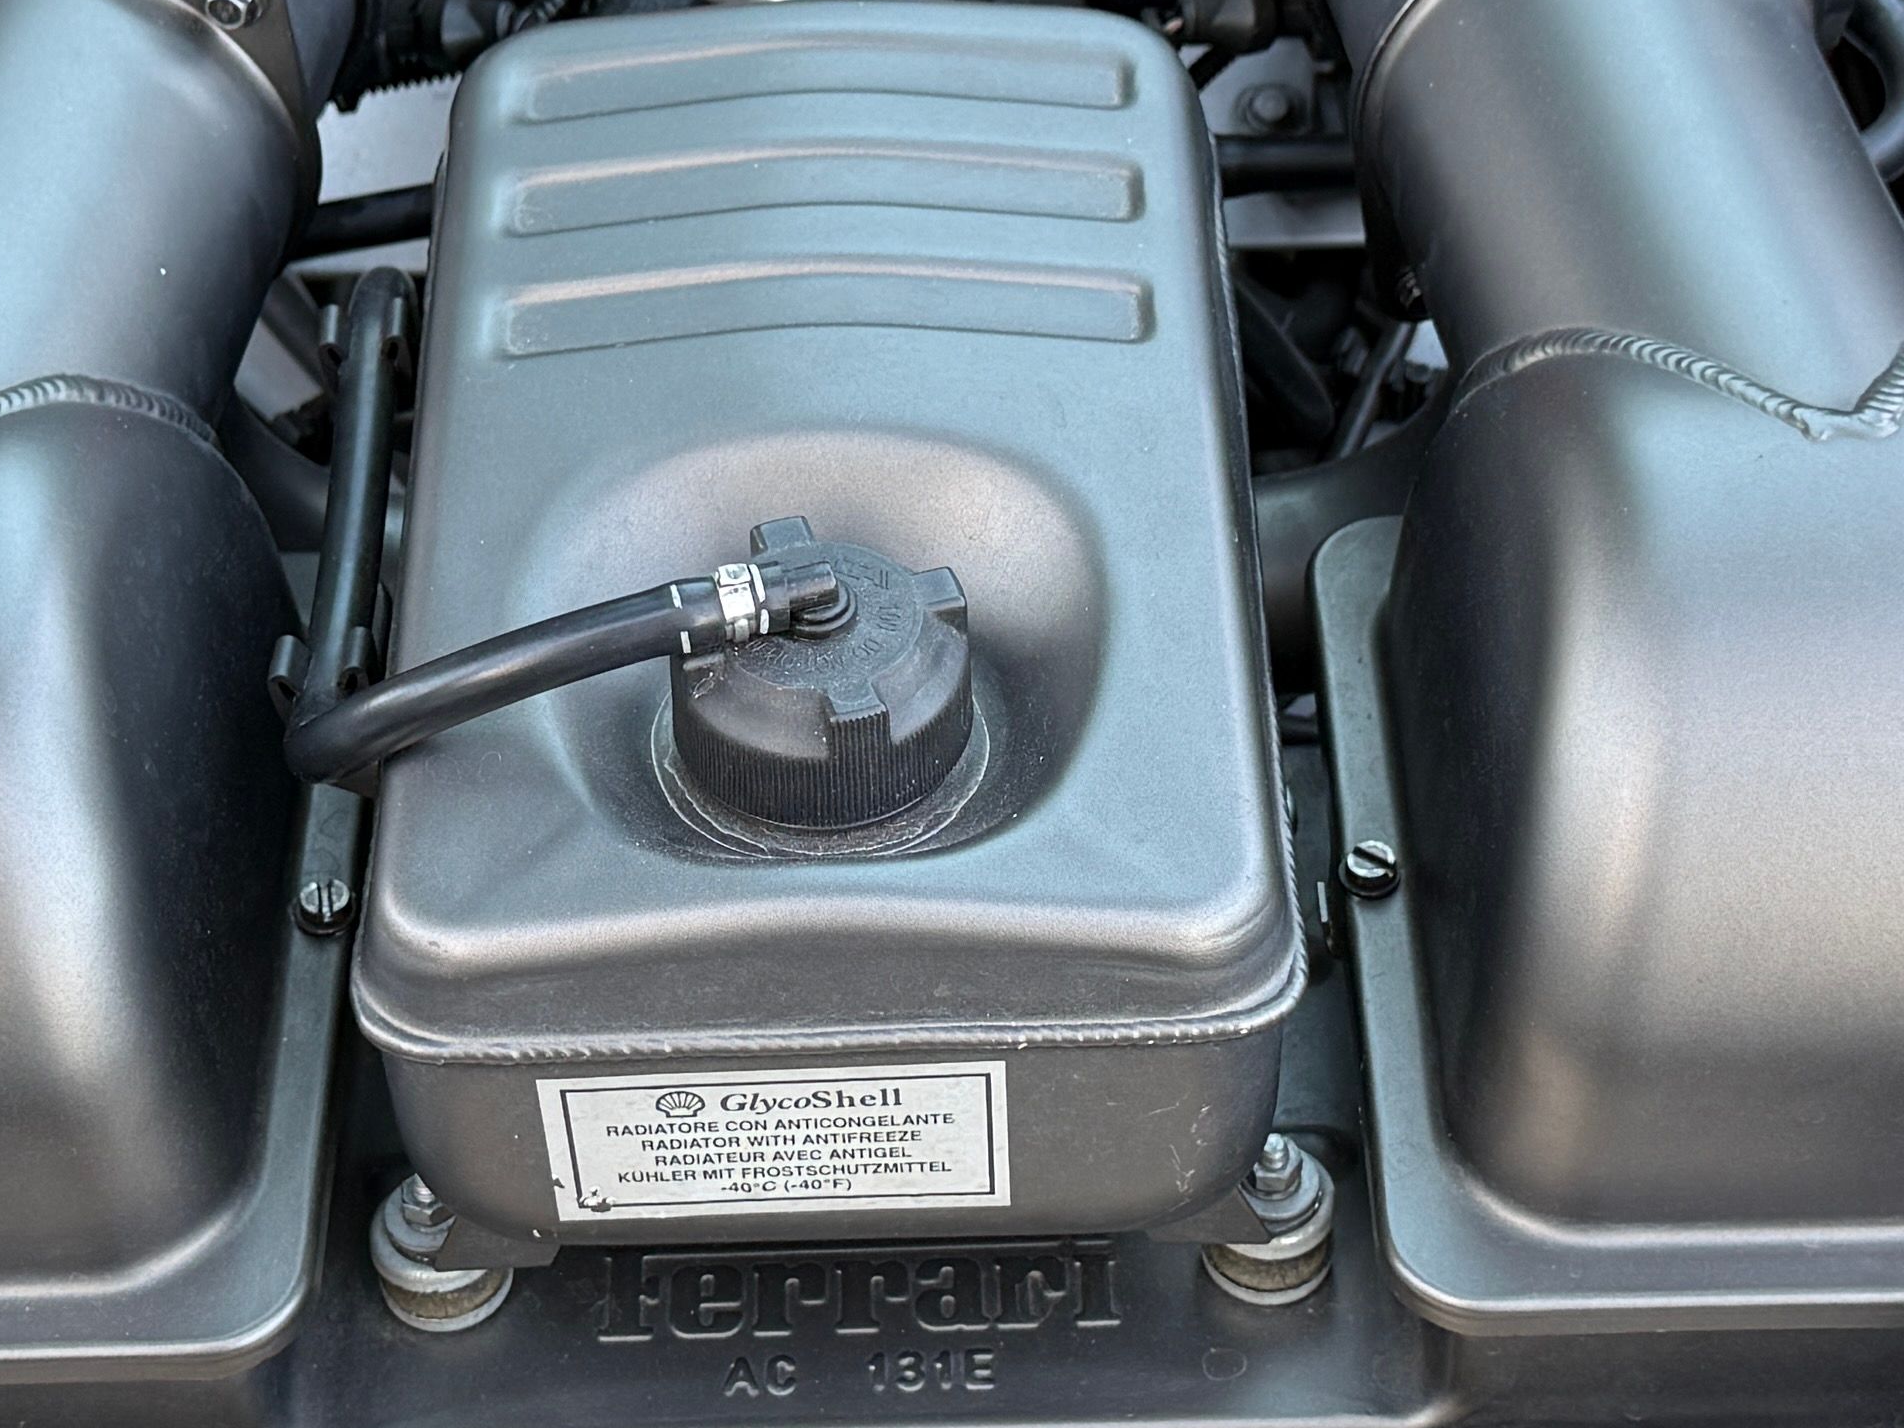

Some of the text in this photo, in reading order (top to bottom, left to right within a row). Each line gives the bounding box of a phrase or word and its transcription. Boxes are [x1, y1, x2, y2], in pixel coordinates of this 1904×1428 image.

[720, 1088, 903, 1115] GlycoShell
[606, 1113, 955, 1137] RADIATORE CON ANTICONGELANTE
[642, 1130, 922, 1152] RADIATOR WITH ANTIFREEZE
[655, 1146, 912, 1166] RADIATEUR AVEC ANTIGEL
[618, 1161, 952, 1183] KÜHLER MIT FROSTSCHUTZMITTEL
[596, 1240, 1122, 1341] Ferrari
[723, 1348, 996, 1397] AC 131E
